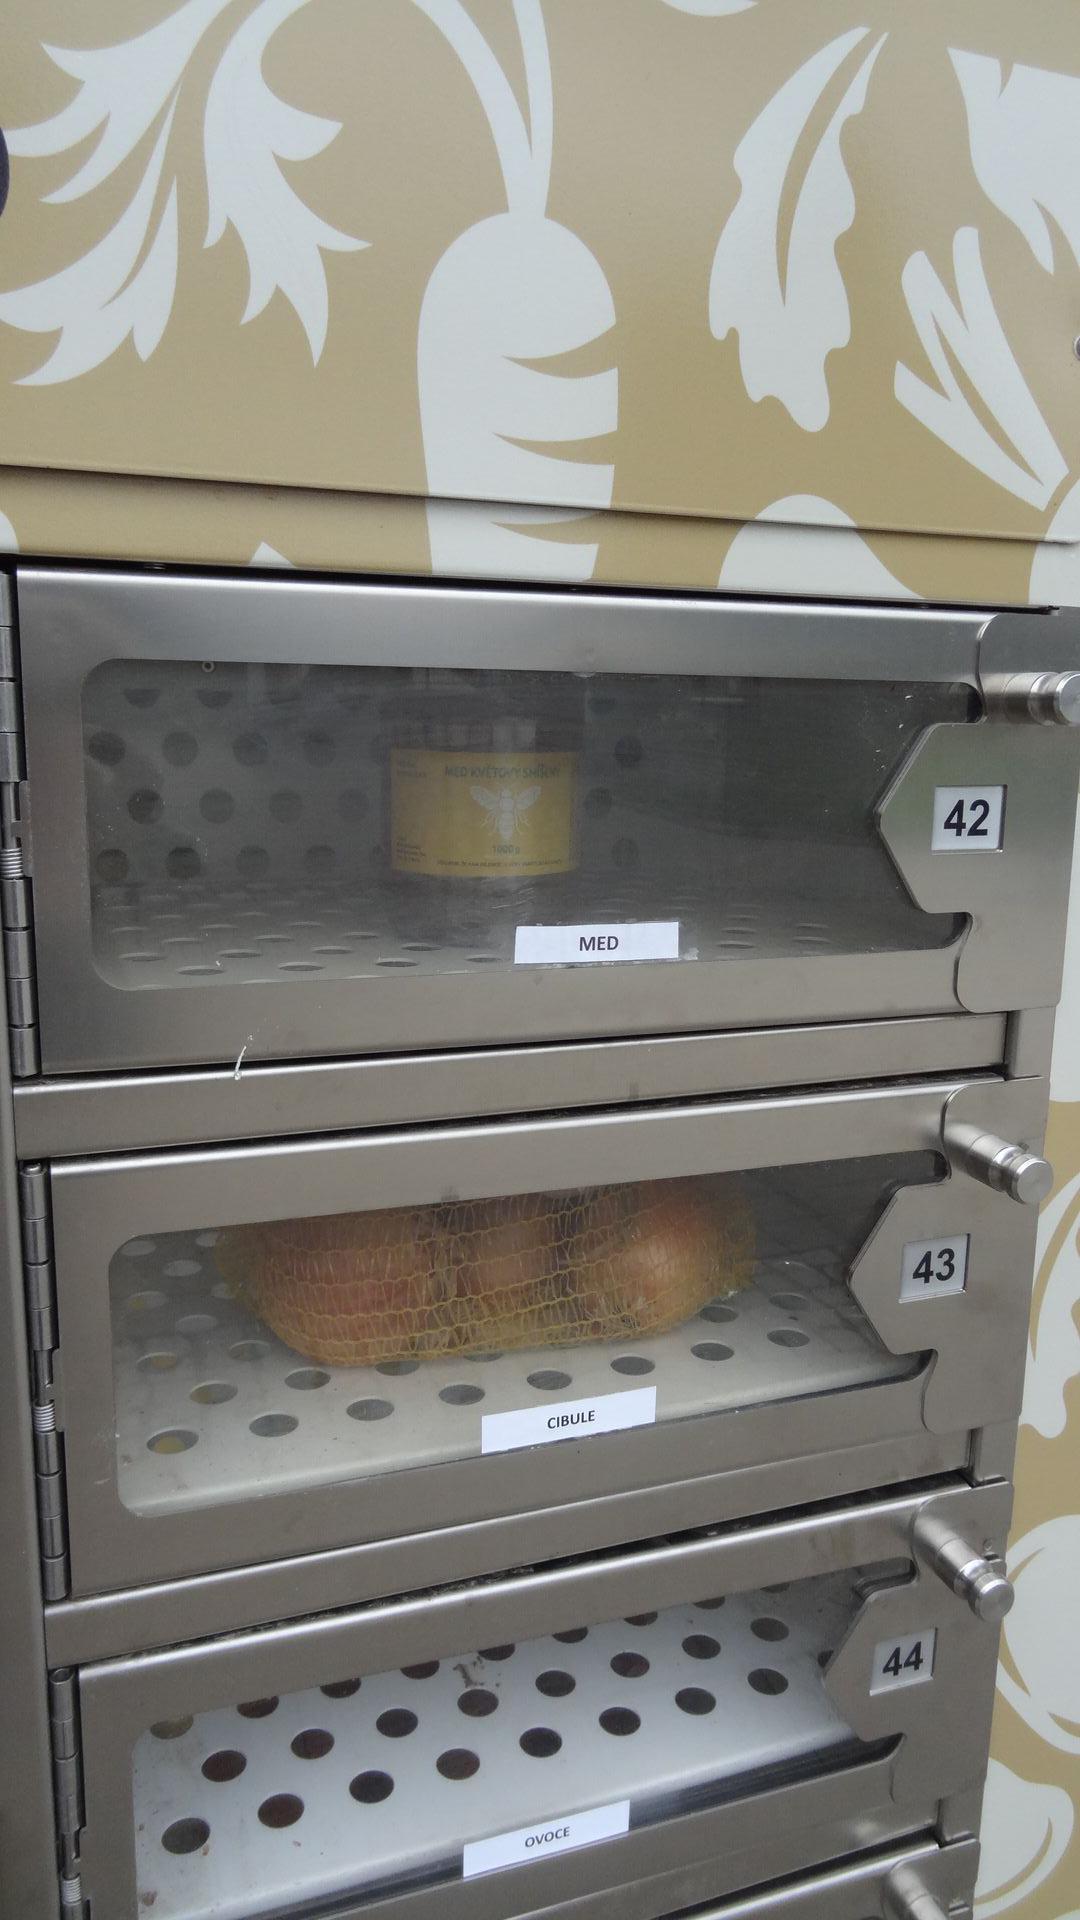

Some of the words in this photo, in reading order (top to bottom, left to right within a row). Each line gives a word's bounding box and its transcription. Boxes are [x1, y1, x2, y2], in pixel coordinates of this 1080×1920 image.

[444, 766, 467, 778] MED
[943, 798, 990, 837] 42
[579, 935, 619, 952] MED
[912, 1247, 955, 1284] 43
[547, 1409, 596, 1429] CIBULE
[882, 1640, 924, 1677] 44
[524, 1826, 571, 1848] OVOCE
